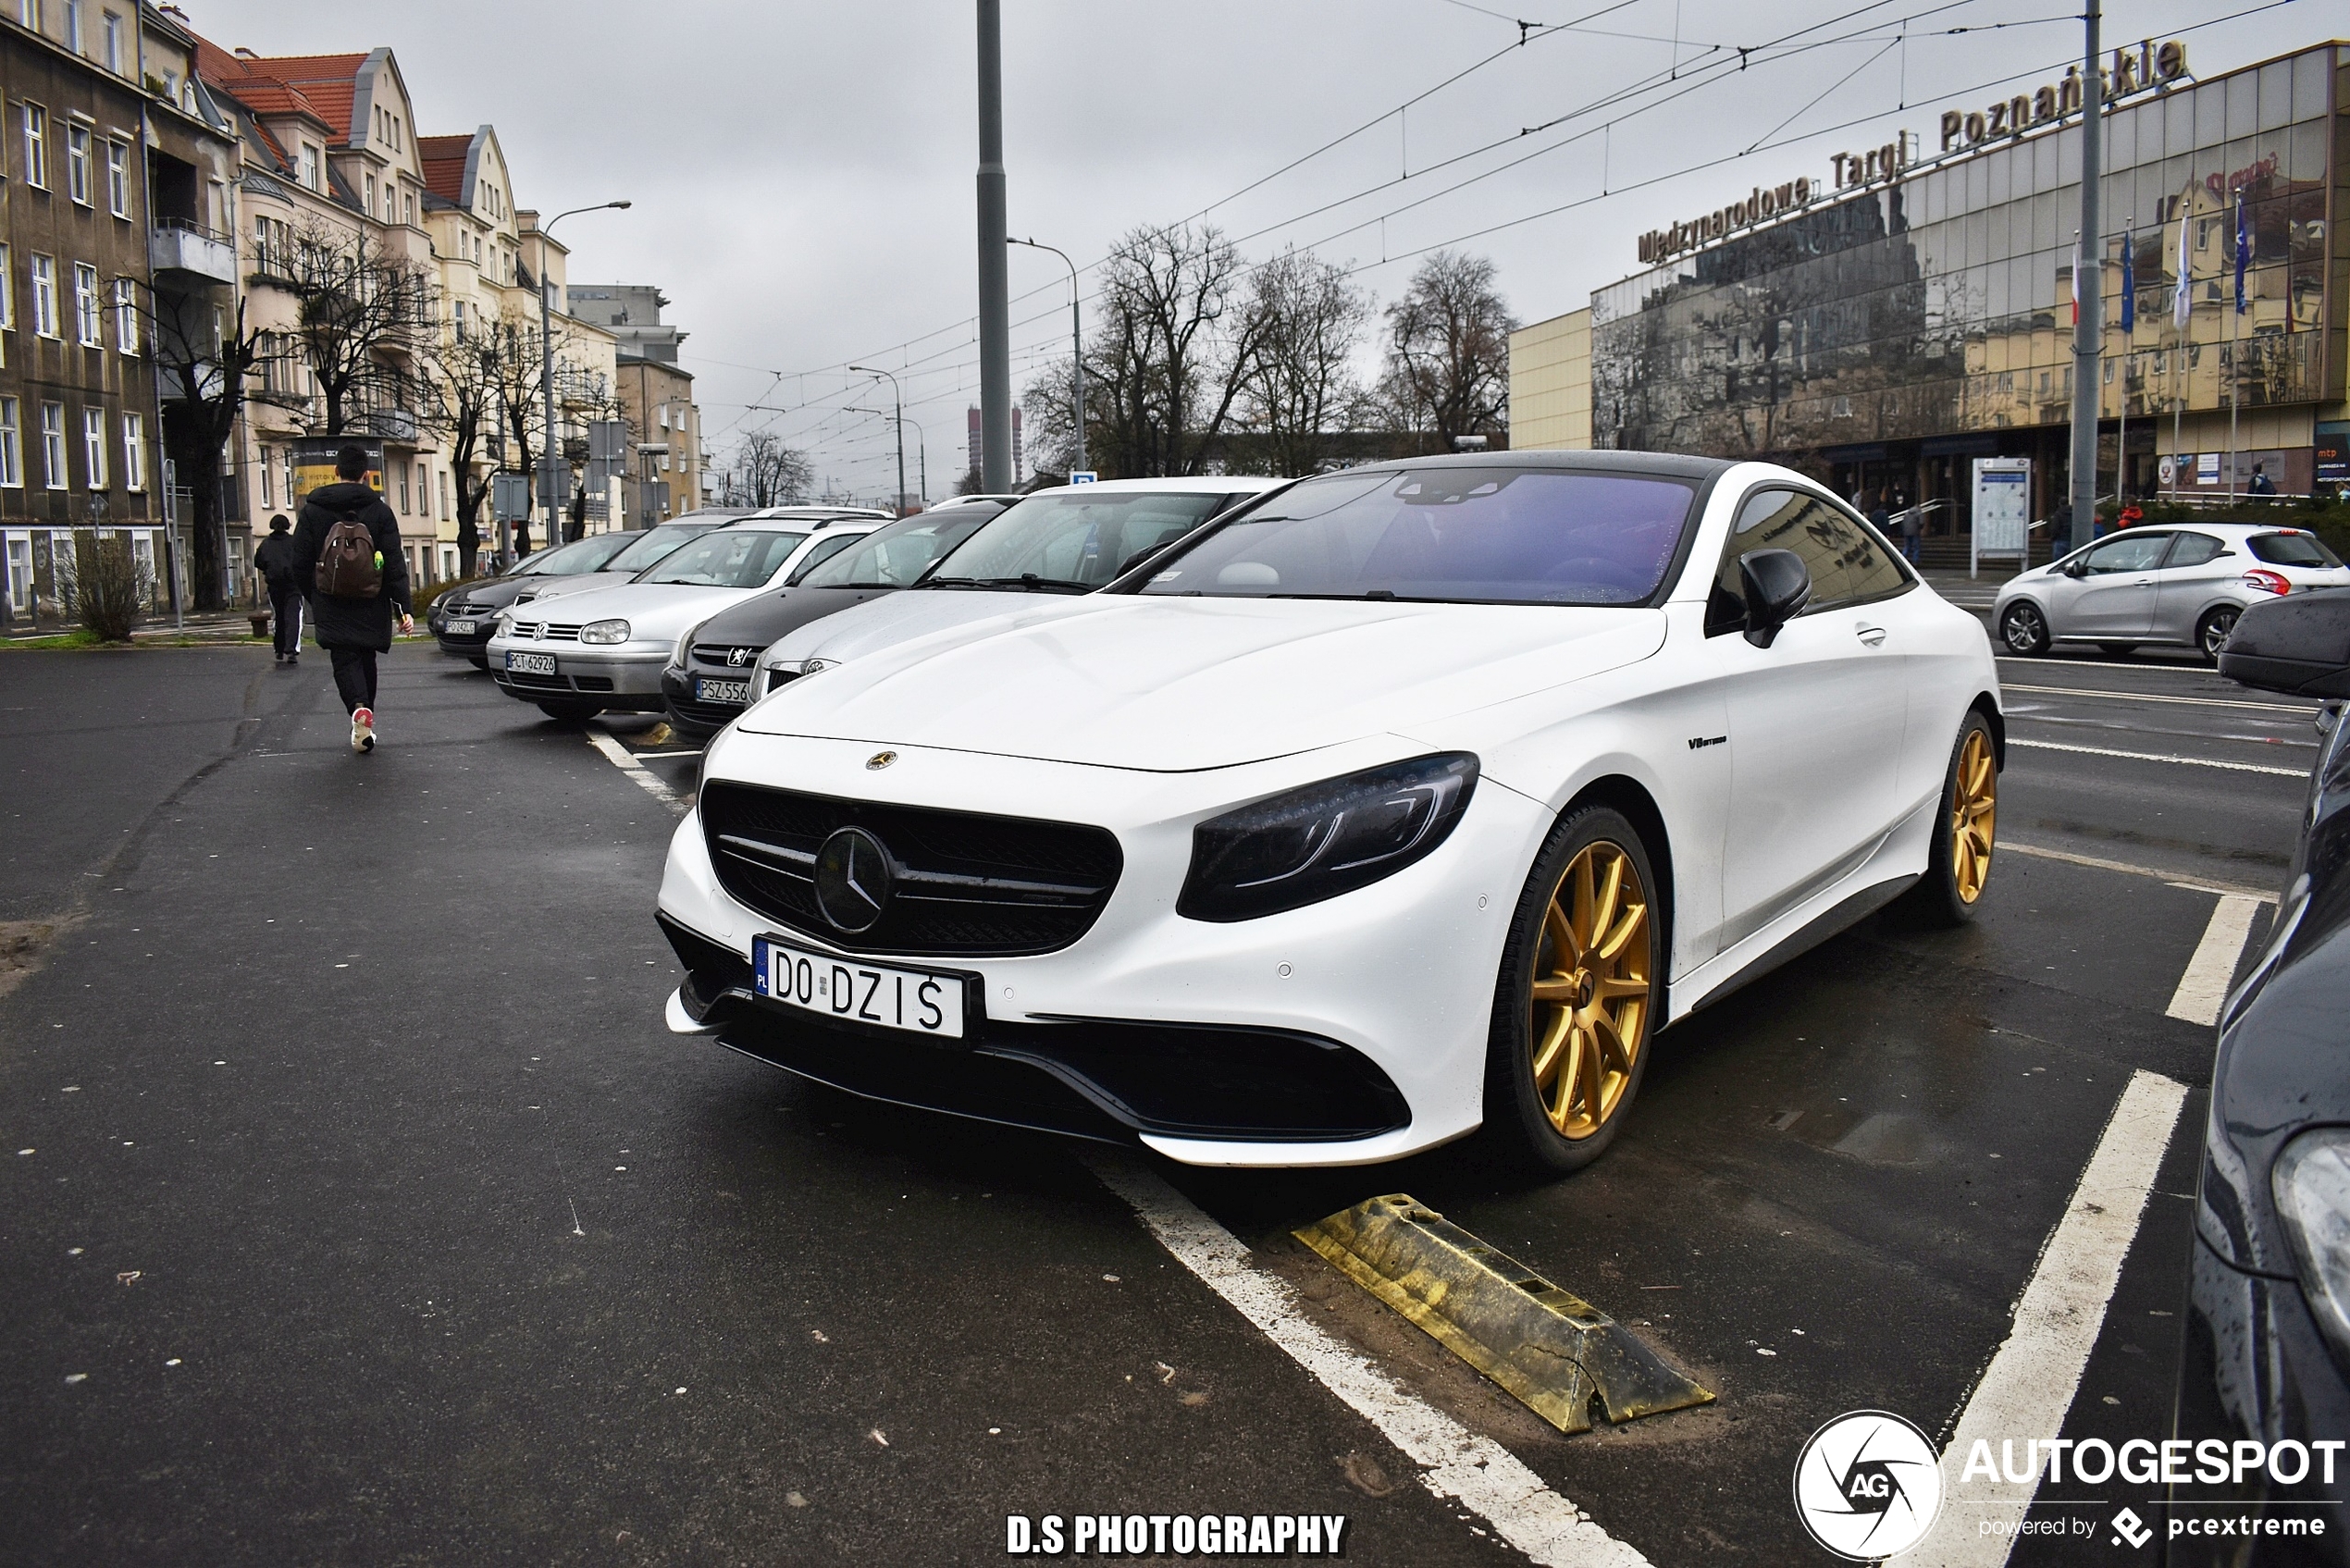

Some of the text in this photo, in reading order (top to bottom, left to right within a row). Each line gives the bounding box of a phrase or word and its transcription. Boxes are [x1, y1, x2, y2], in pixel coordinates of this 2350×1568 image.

[1639, 176, 1810, 264] Międzynarodowe
[1831, 130, 1907, 183] Targi
[2318, 450, 2337, 459] mtp
[512, 653, 526, 668] PCT
[528, 655, 554, 671] 62926
[701, 680, 722, 698] PSZ
[757, 973, 767, 989] PL
[775, 950, 943, 1030] DO DZIŚ
